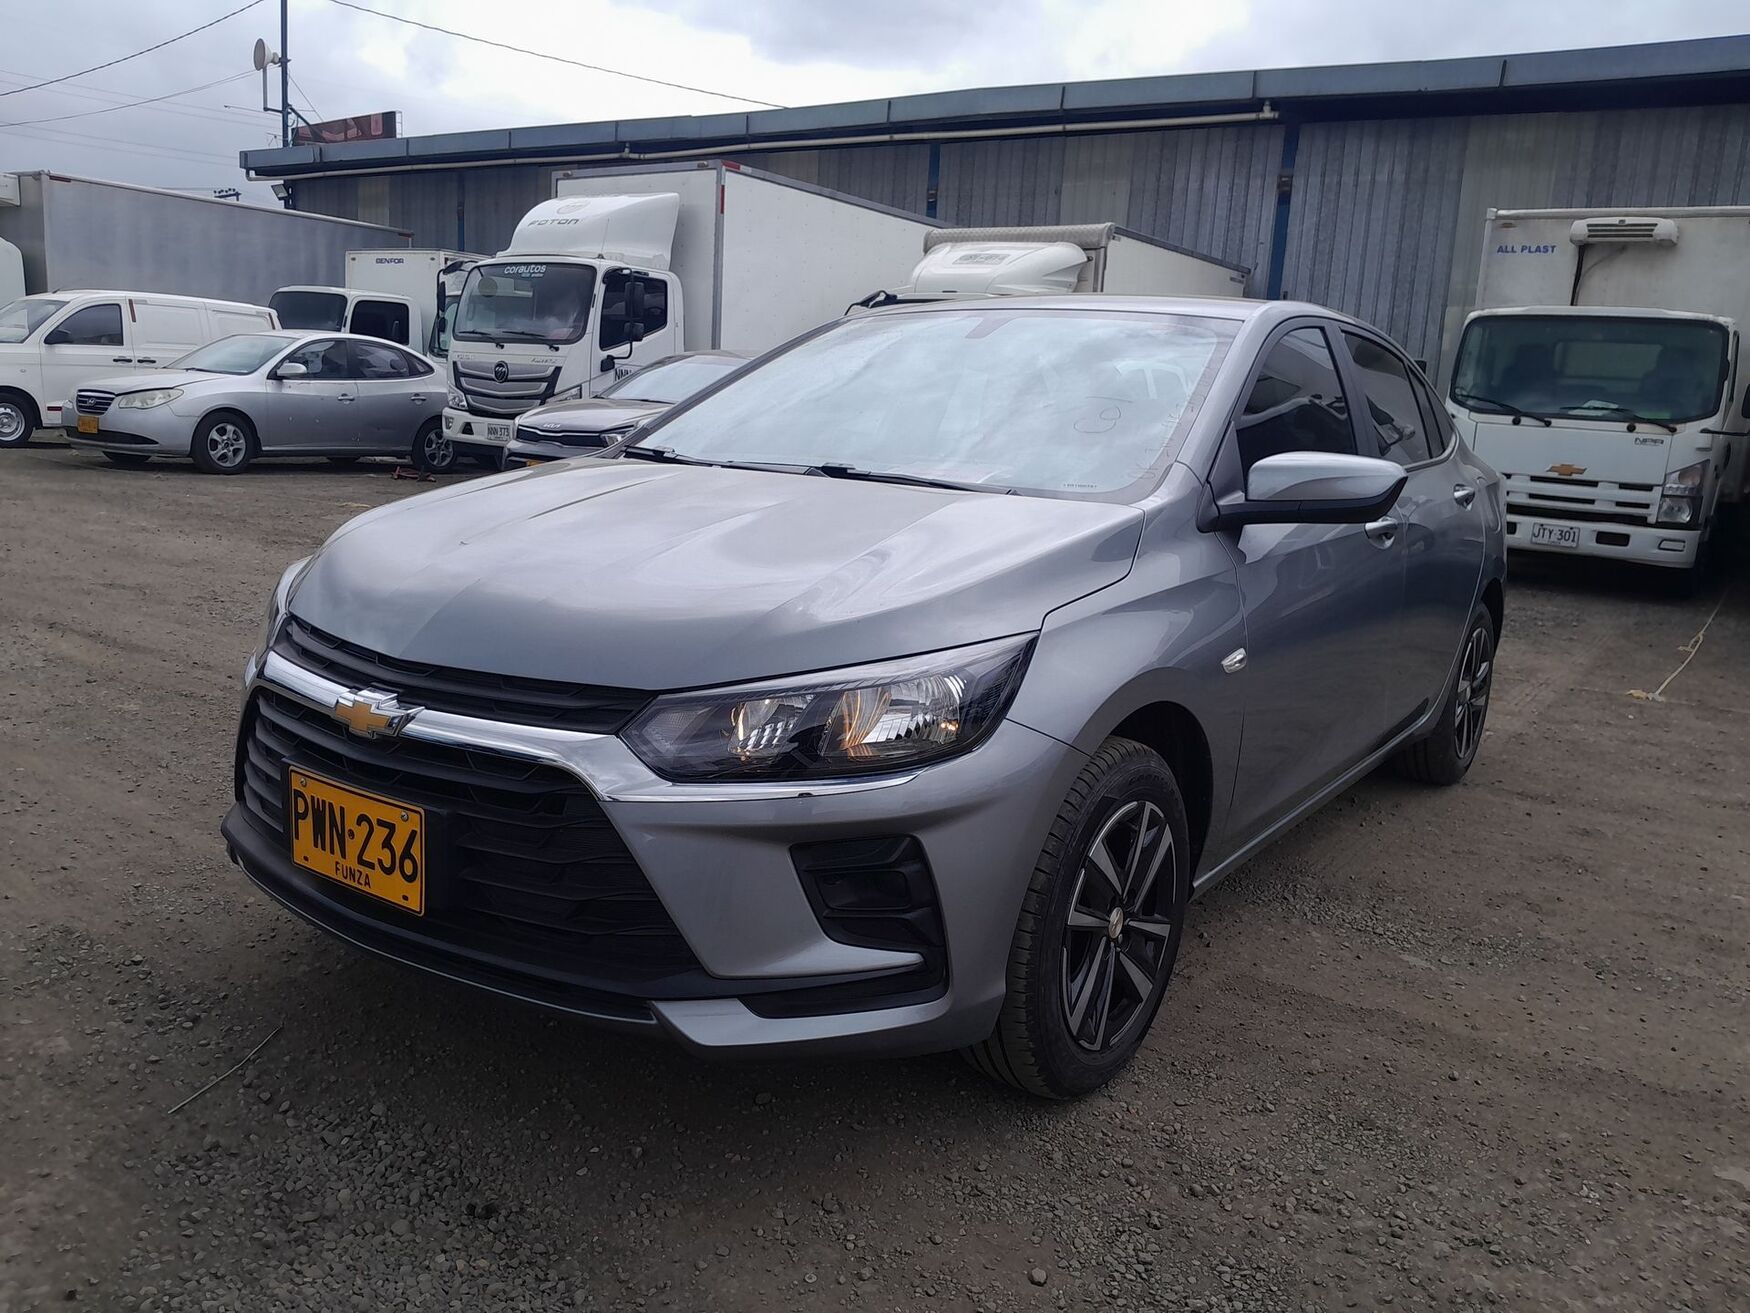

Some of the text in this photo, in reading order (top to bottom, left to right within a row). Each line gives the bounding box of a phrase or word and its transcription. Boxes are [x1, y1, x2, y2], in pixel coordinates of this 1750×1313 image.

[1496, 244, 1557, 254] ALL PLAST
[504, 264, 547, 274] corautos
[335, 861, 371, 889] FUNZA
